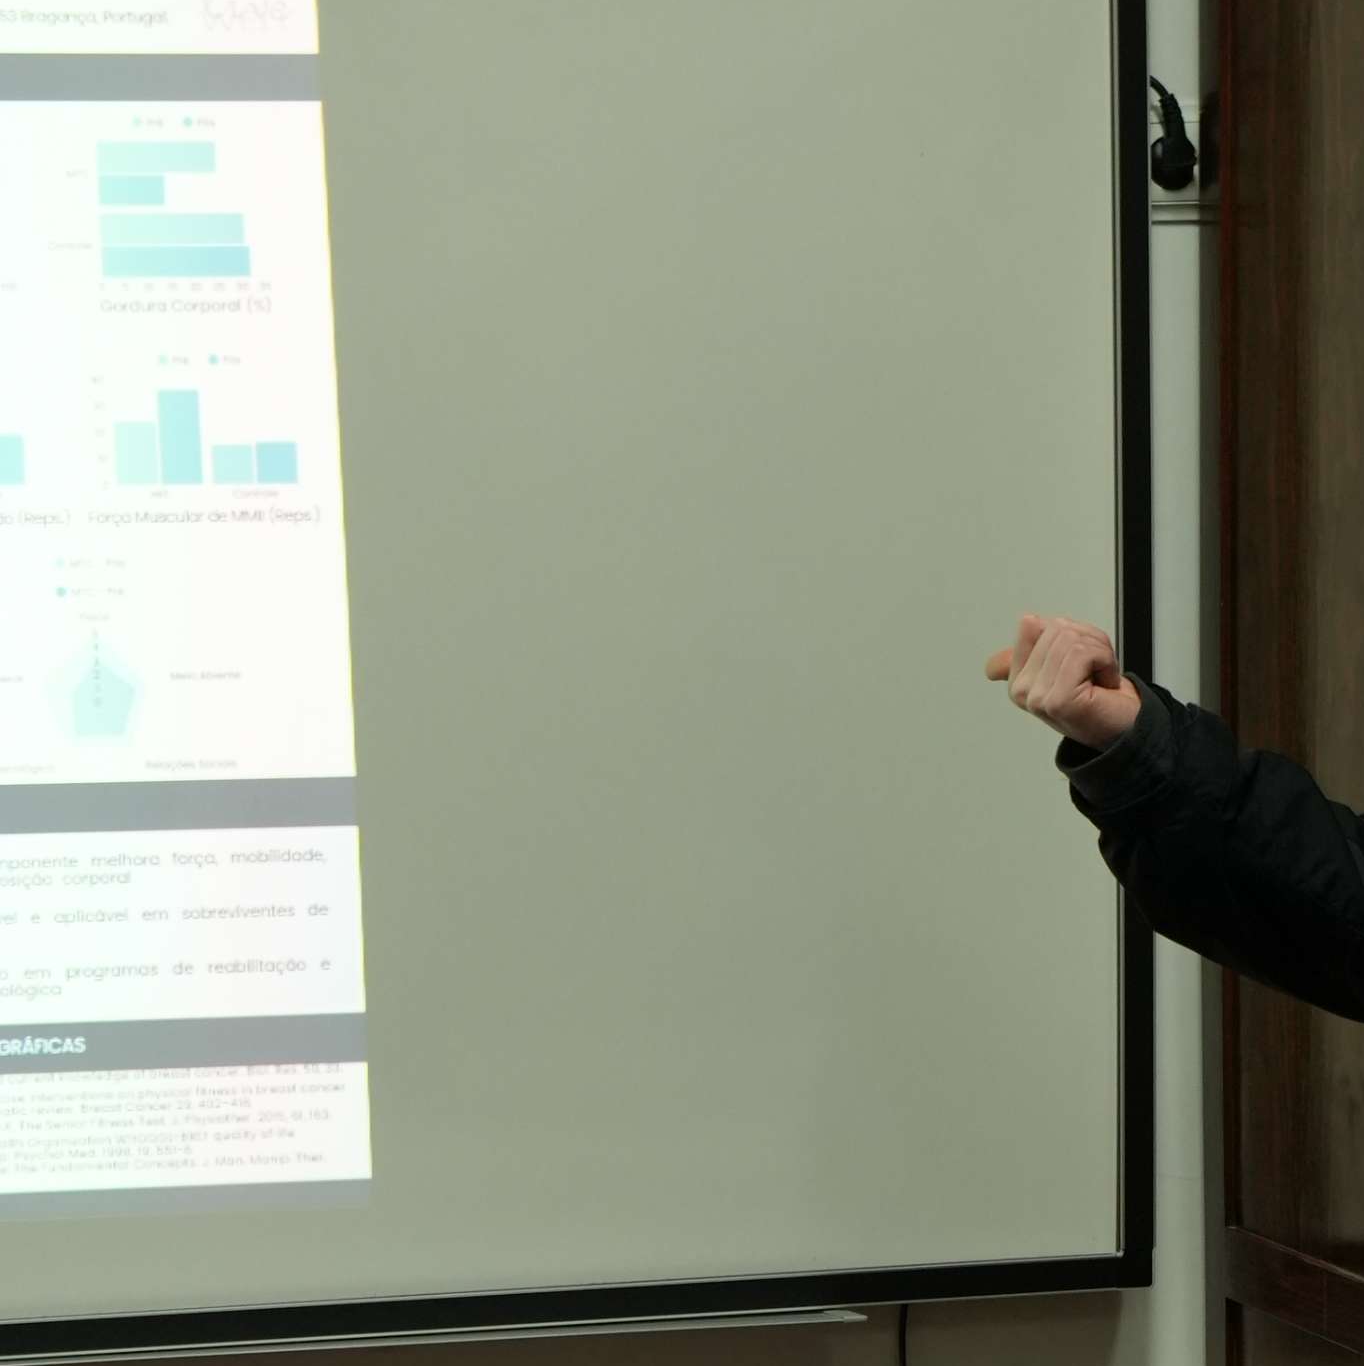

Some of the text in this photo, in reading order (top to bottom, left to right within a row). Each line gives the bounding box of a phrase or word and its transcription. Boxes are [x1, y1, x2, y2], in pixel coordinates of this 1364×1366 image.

[100, 298, 168, 314] Gordura
[171, 298, 241, 316] Corporal
[135, 509, 203, 524] Muscular
[209, 509, 228, 524] de
[91, 848, 327, 868] melhora força, mobilidade,
[63, 871, 131, 888] corporal
[182, 903, 296, 921] sobreviventes
[308, 903, 329, 917] de
[65, 965, 159, 982] programas
[172, 962, 194, 976] de
